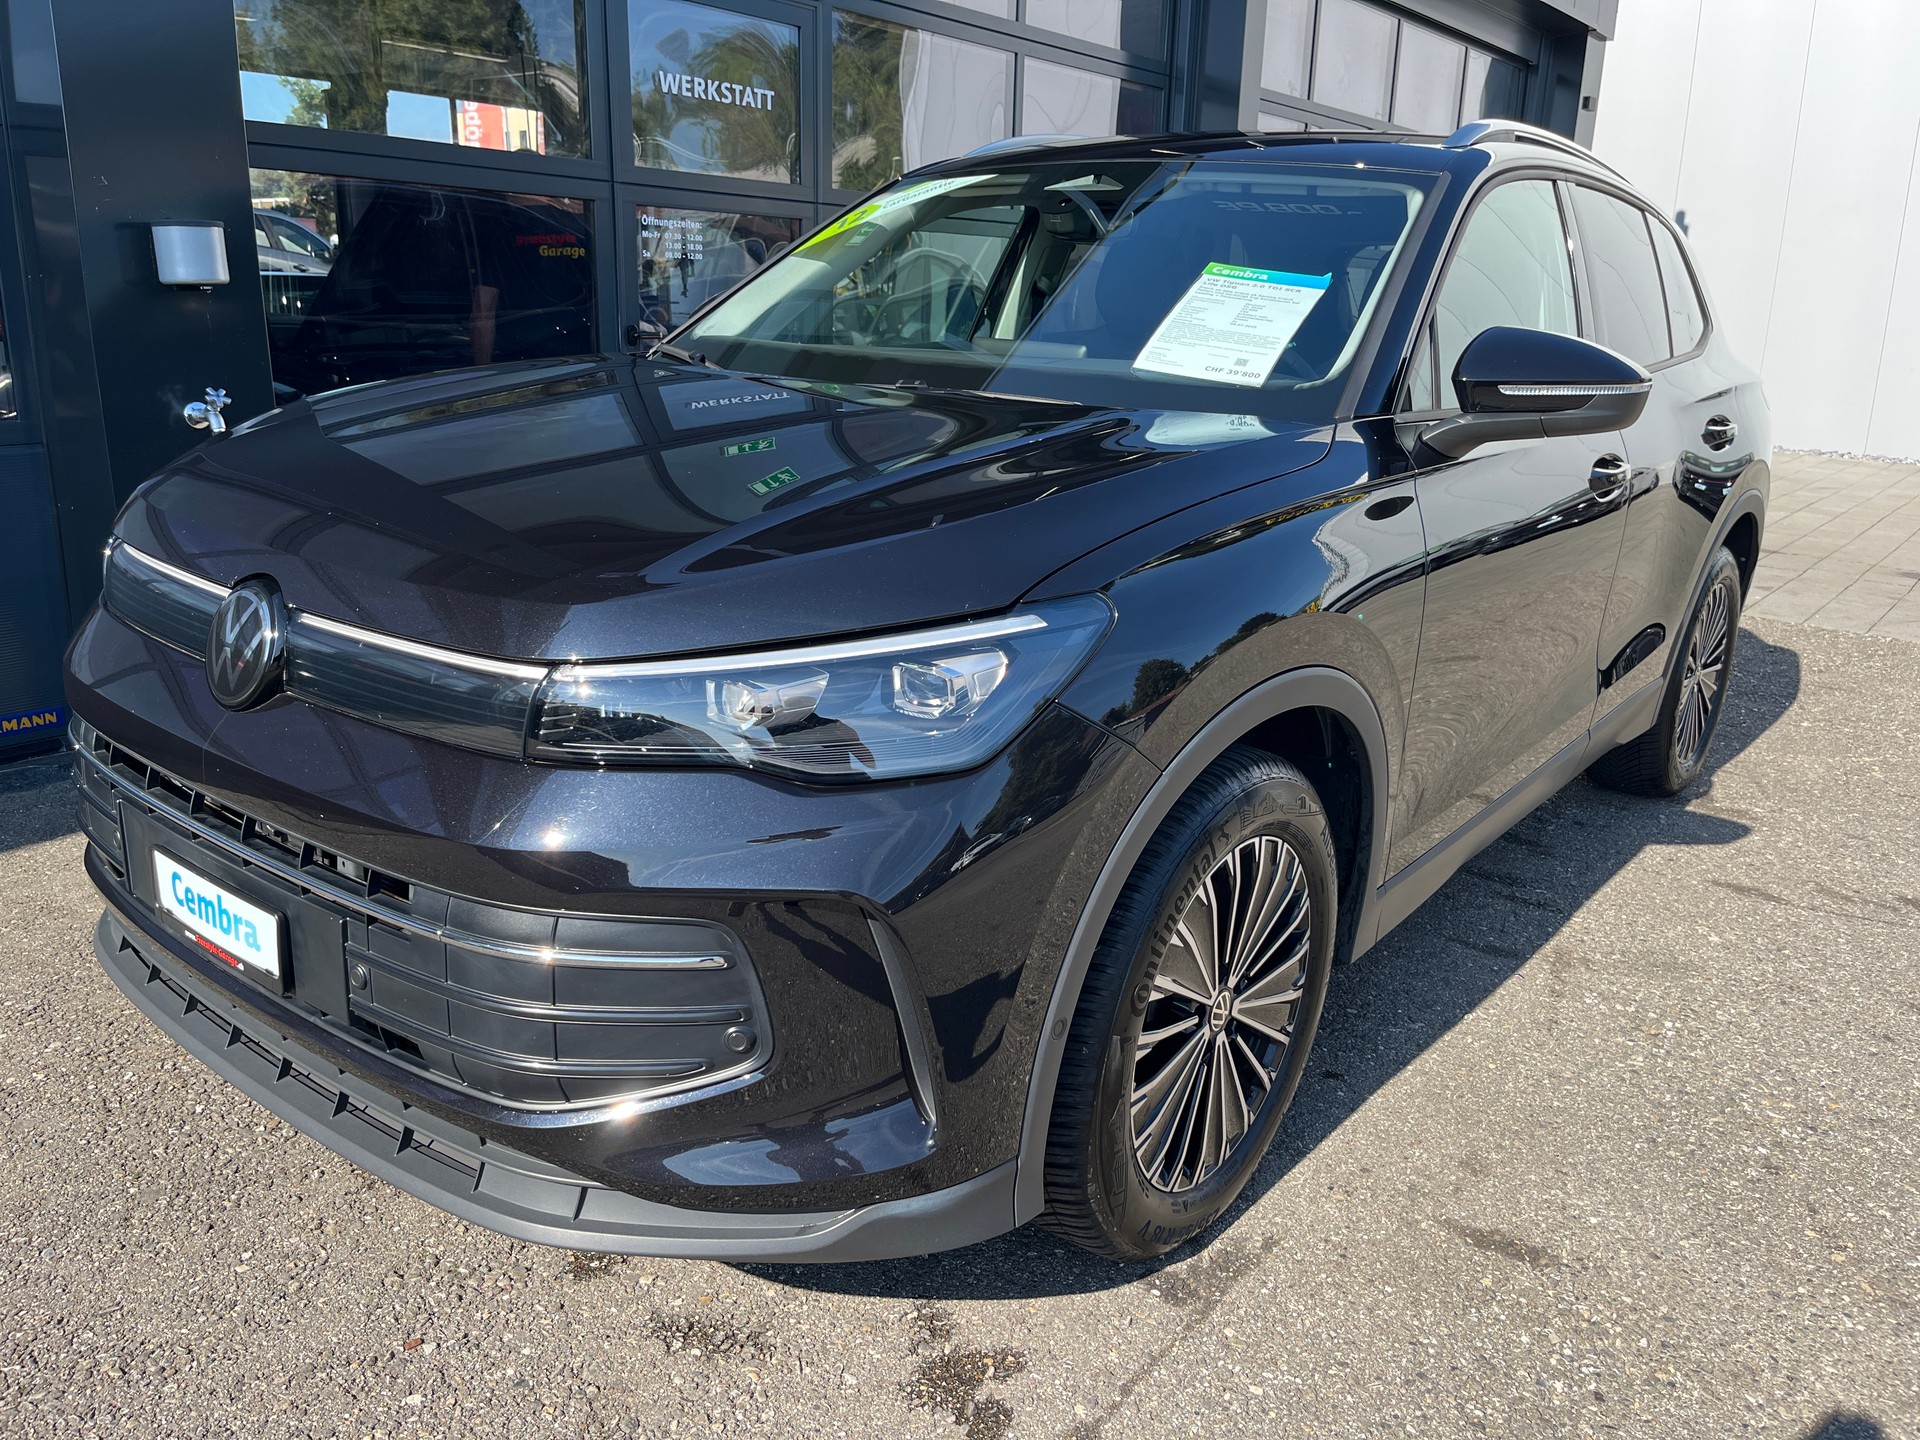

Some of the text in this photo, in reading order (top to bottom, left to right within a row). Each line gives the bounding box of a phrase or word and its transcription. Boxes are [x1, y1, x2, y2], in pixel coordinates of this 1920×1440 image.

[658, 70, 775, 111] WERKSTATT
[641, 214, 703, 229] Öffnungszeiten:
[642, 230, 661, 239] Mo-Fr
[664, 232, 682, 240] 07.30
[687, 234, 703, 242] 12.00
[539, 245, 586, 259] Garage
[665, 242, 682, 250] 13.00
[687, 243, 703, 251] 18.00
[642, 249, 651, 257] Sa
[687, 252, 703, 260] 12.00
[1212, 266, 1269, 281] Cembra
[1226, 368, 1261, 379] 39'800
[0, 711, 57, 733] MANN
[171, 871, 262, 952] Cembra
[1131, 841, 1218, 1018] Continental
